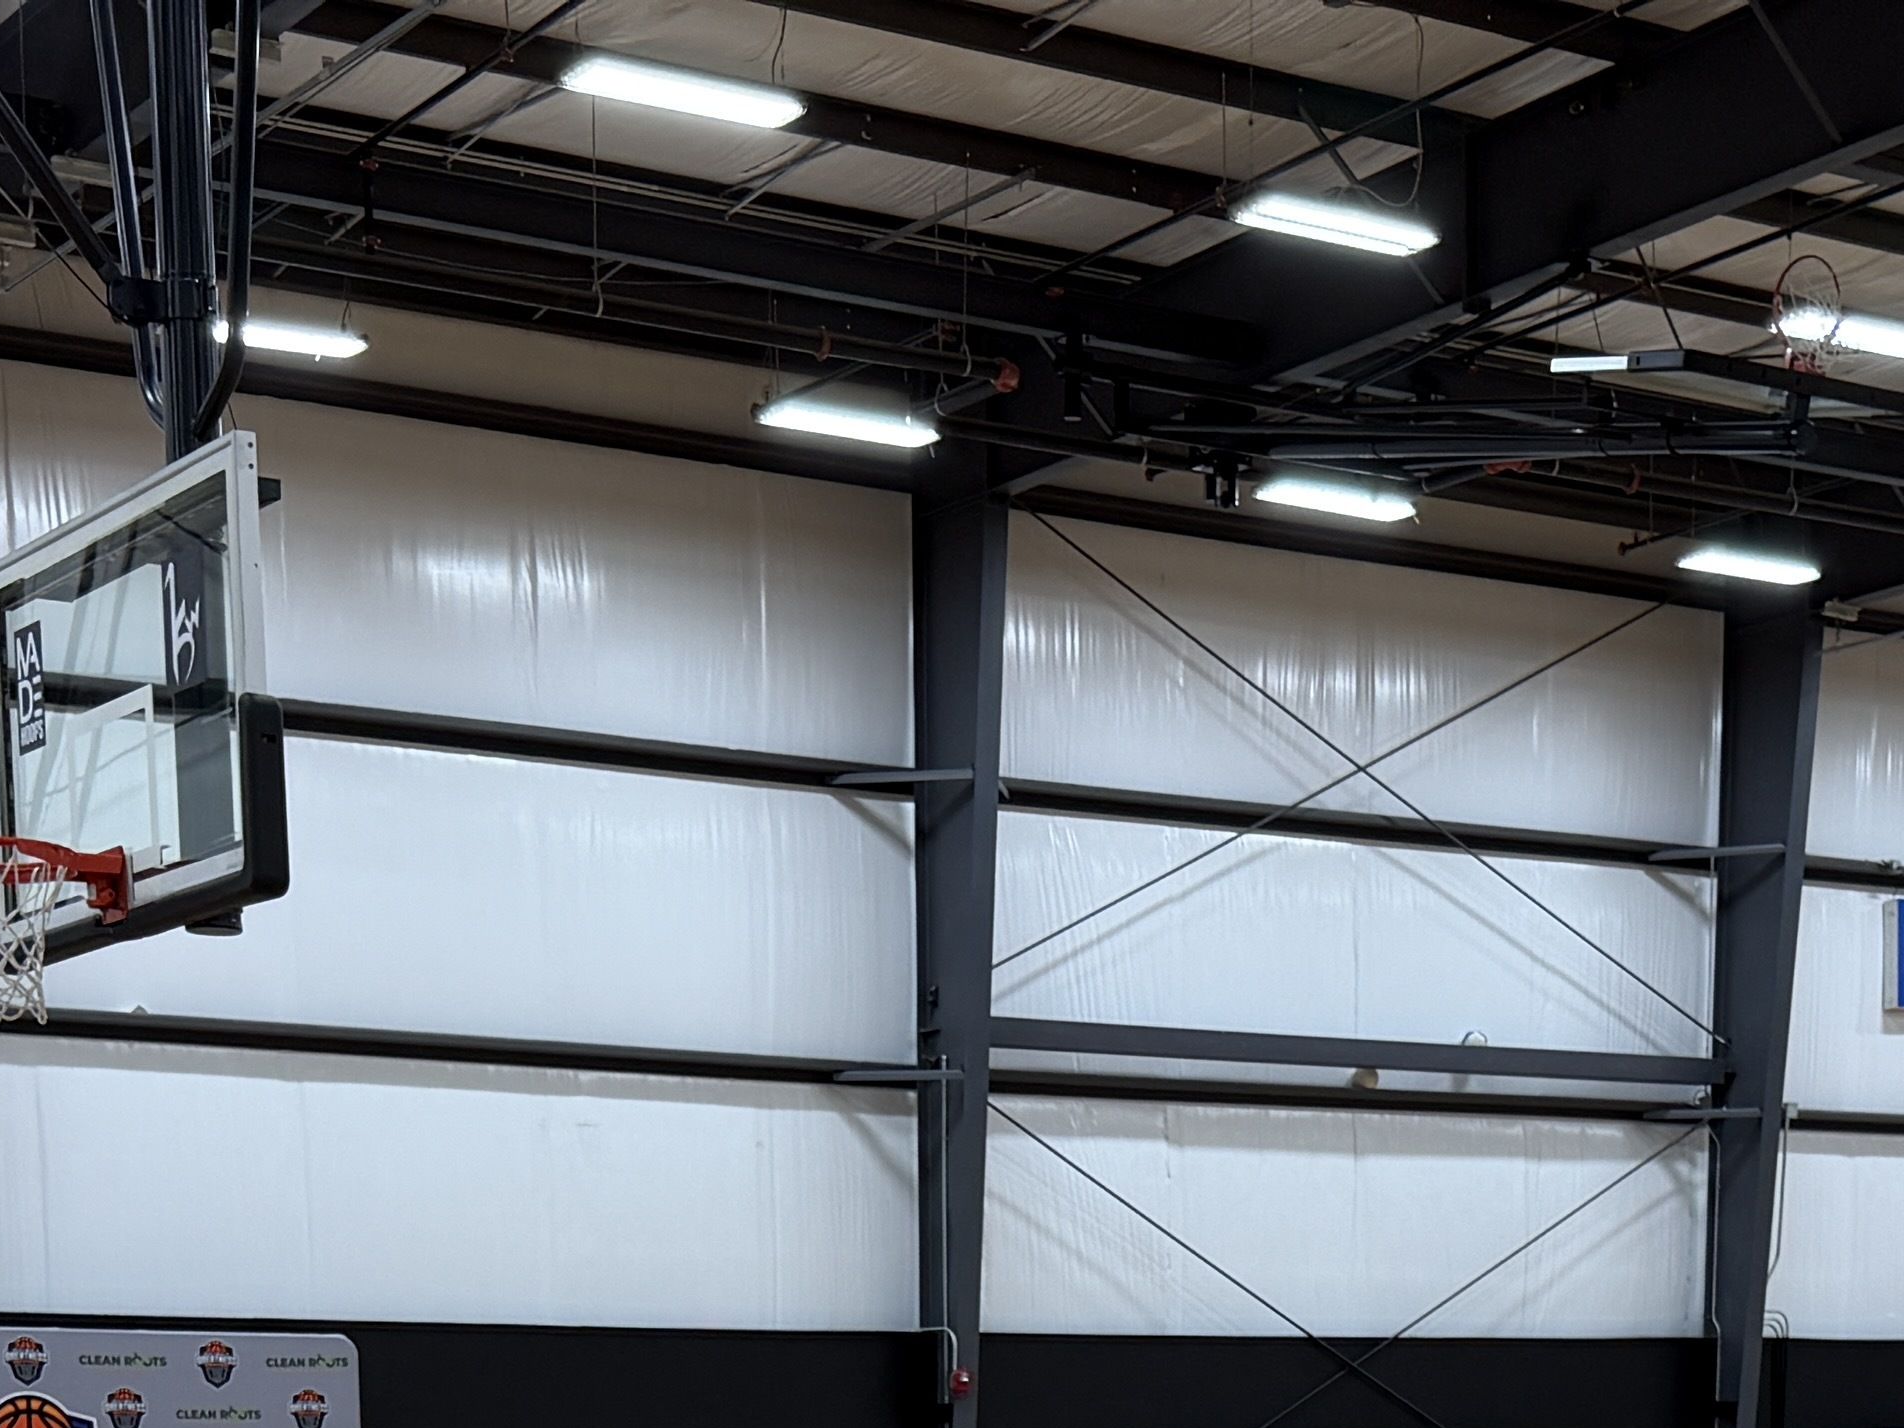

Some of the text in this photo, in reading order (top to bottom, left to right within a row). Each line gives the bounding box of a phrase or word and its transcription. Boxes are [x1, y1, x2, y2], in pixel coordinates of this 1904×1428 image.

[80, 1354, 121, 1366] CLEAN
[266, 1358, 306, 1368] CLEAN
[176, 1410, 216, 1420] CLEAN
